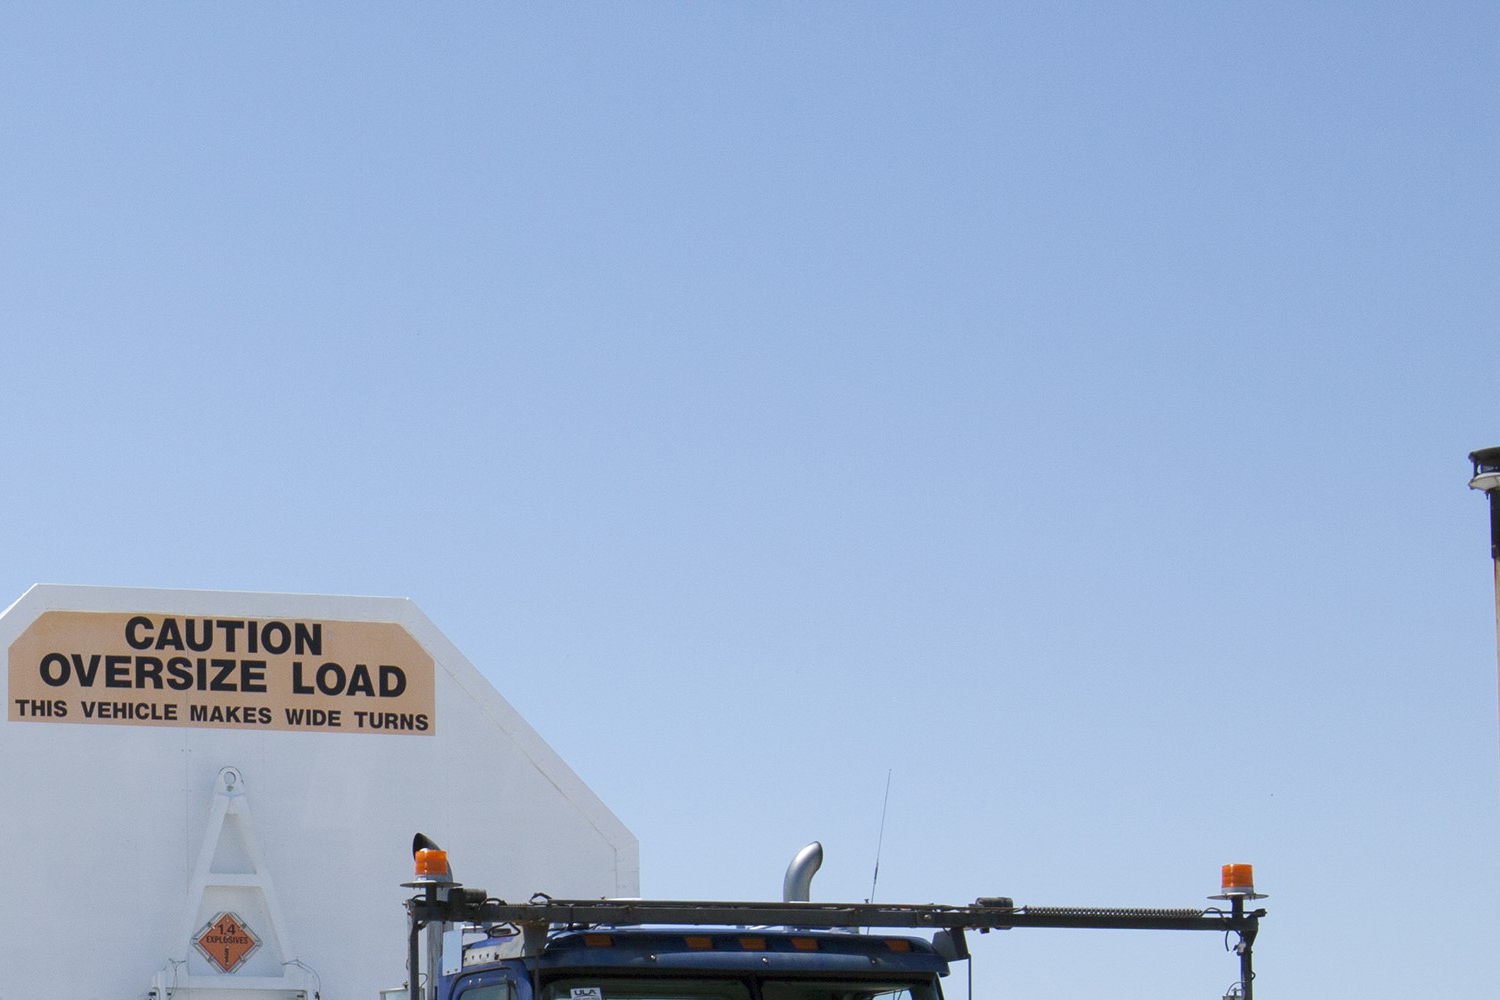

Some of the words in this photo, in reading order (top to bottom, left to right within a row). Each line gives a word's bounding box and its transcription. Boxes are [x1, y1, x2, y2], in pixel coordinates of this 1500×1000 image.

[125, 616, 322, 656] CAUTION
[39, 653, 267, 693] OVERSIZE
[293, 661, 406, 698] LOAD
[15, 699, 67, 717] THIS
[81, 701, 177, 721] VEHICLE
[190, 705, 272, 725] MAKES
[285, 709, 341, 727] WIDE
[354, 711, 429, 731] TURNS
[206, 935, 249, 944] EXPLOSIVES
[218, 924, 236, 935] 1.4
